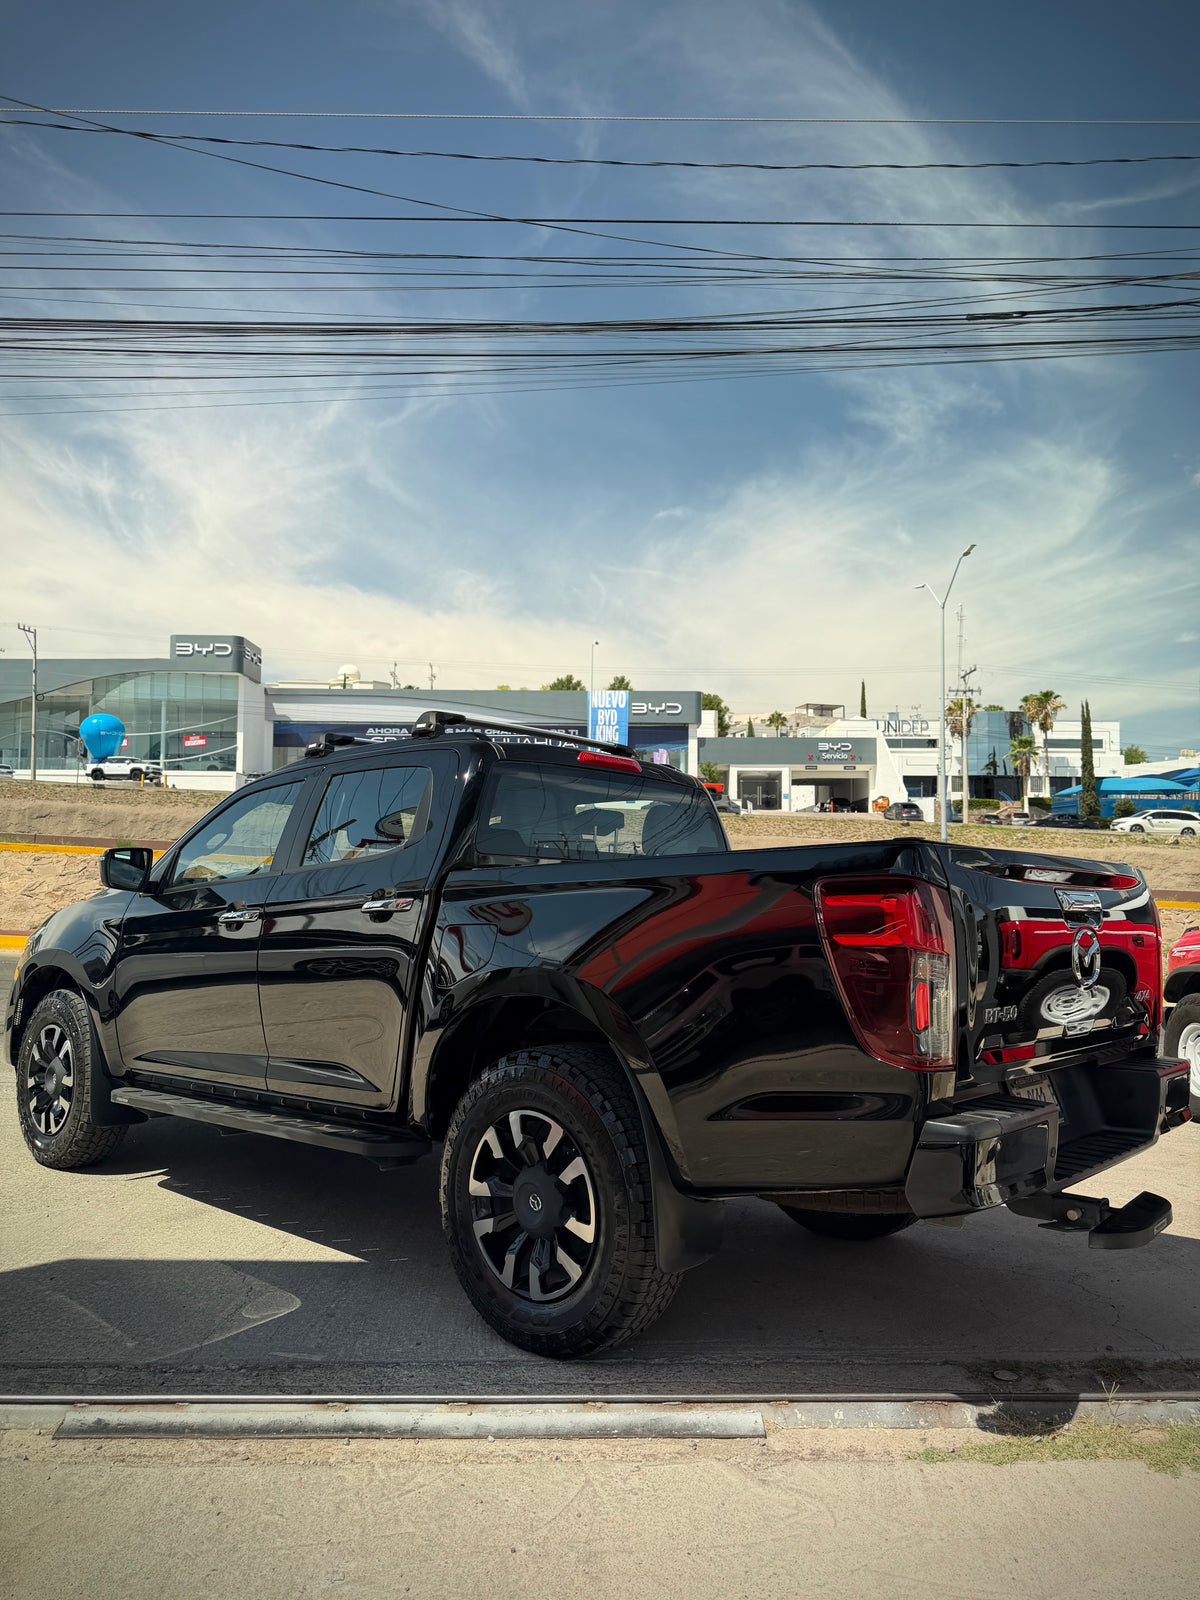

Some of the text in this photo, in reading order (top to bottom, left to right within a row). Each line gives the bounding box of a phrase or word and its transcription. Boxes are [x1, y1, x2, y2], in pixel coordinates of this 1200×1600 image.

[175, 643, 232, 655] BYD
[592, 691, 626, 709] NUEVO
[631, 703, 683, 714] BYD
[597, 709, 618, 726] BYD
[595, 725, 619, 744] KING
[876, 720, 929, 734] UNIDEP
[822, 752, 848, 760] Servicio
[984, 1005, 1018, 1024] BT-50
